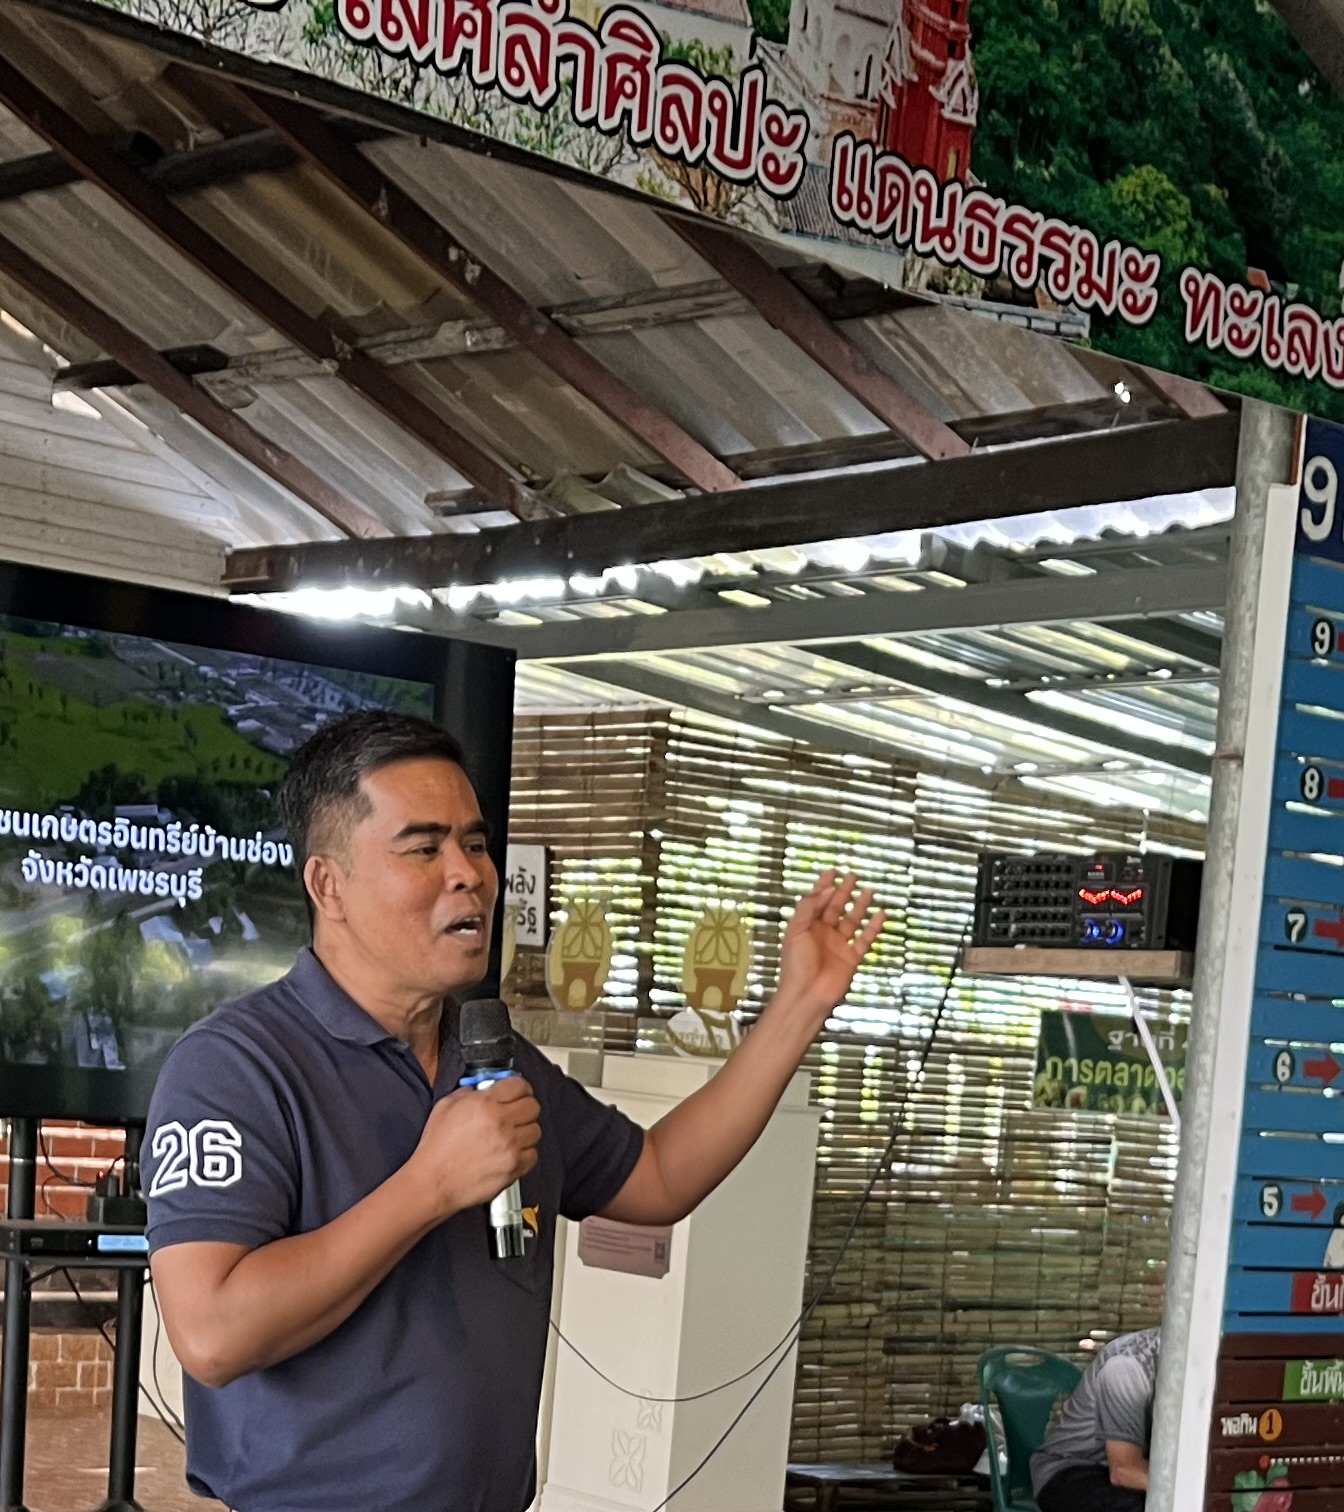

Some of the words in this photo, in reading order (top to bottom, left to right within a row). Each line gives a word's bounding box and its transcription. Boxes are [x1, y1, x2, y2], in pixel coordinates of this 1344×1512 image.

[836, 136, 1156, 320] แดนธรรมะ
[1301, 455, 1338, 541] 9
[1315, 622, 1330, 654] 9
[1305, 767, 1319, 799] 8
[22, 849, 203, 908] จังหวัดเพชรบุรี
[1287, 913, 1305, 943] 7
[1277, 1052, 1291, 1081] 6
[149, 1120, 243, 1197] 26
[1264, 1186, 1278, 1217] 5
